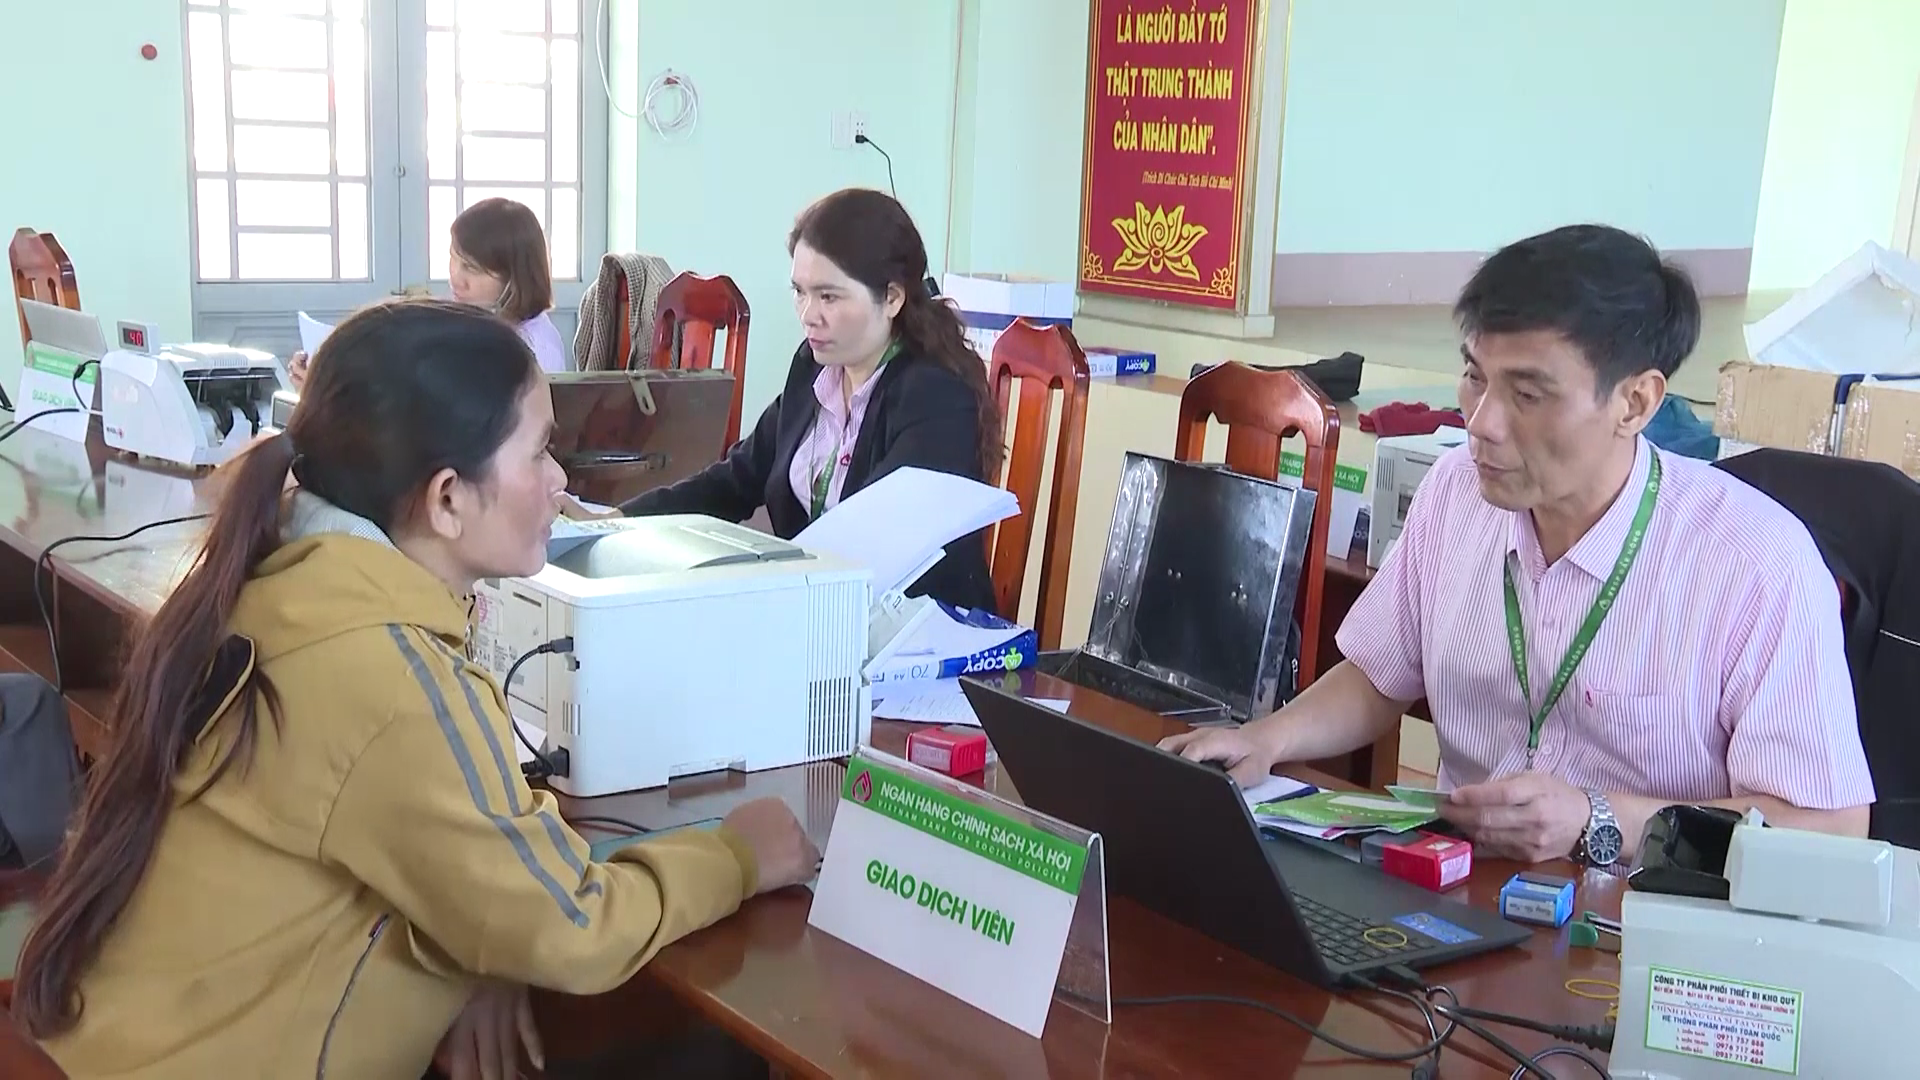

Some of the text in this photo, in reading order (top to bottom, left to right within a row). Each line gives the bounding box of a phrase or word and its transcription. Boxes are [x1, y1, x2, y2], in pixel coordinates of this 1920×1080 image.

[1116, 0, 1228, 44] LÀ NGƯỜI ĐẦY TỚ
[1106, 60, 1233, 106] THẬT TRUNG THÀNH
[1113, 110, 1138, 150] CỦA
[1141, 116, 1178, 152] NHÂN
[962, 656, 1005, 674] COPY
[878, 799, 1066, 884] VIETNAM BANK FOR SOCIAL POLICIES
[951, 808, 991, 837] CHÍNH
[990, 826, 1026, 853] SÁCH
[866, 859, 1016, 946] GIAO DỊCH VIÊN
[1654, 974, 1674, 986] CÔNG
[1676, 978, 1685, 987] TY
[1730, 987, 1750, 998] THIẾT
[1752, 992, 1760, 1000] BỊ
[1762, 994, 1778, 1003] KHO
